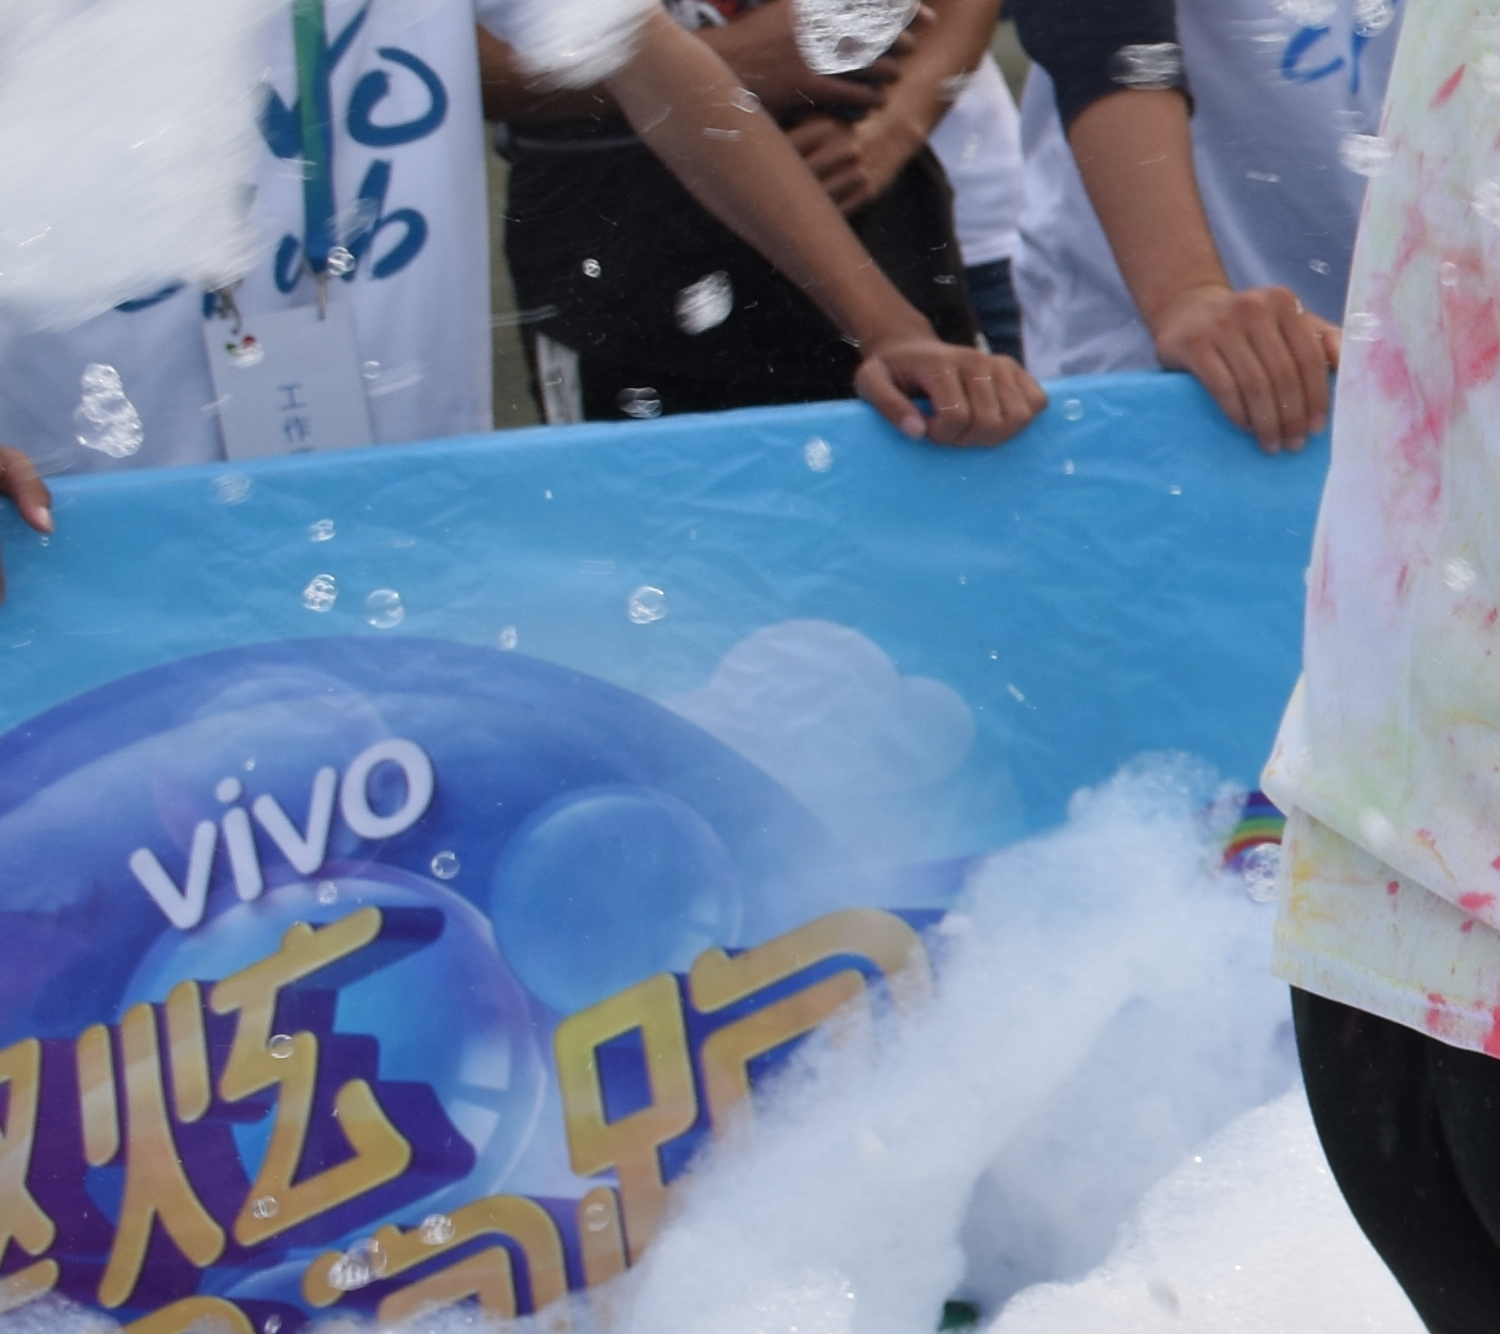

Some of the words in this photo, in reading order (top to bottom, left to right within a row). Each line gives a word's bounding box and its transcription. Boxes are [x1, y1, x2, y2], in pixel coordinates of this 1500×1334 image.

[278, 382, 315, 455] 工作
[129, 738, 434, 931] vivo
[0, 905, 412, 1312] 炫
